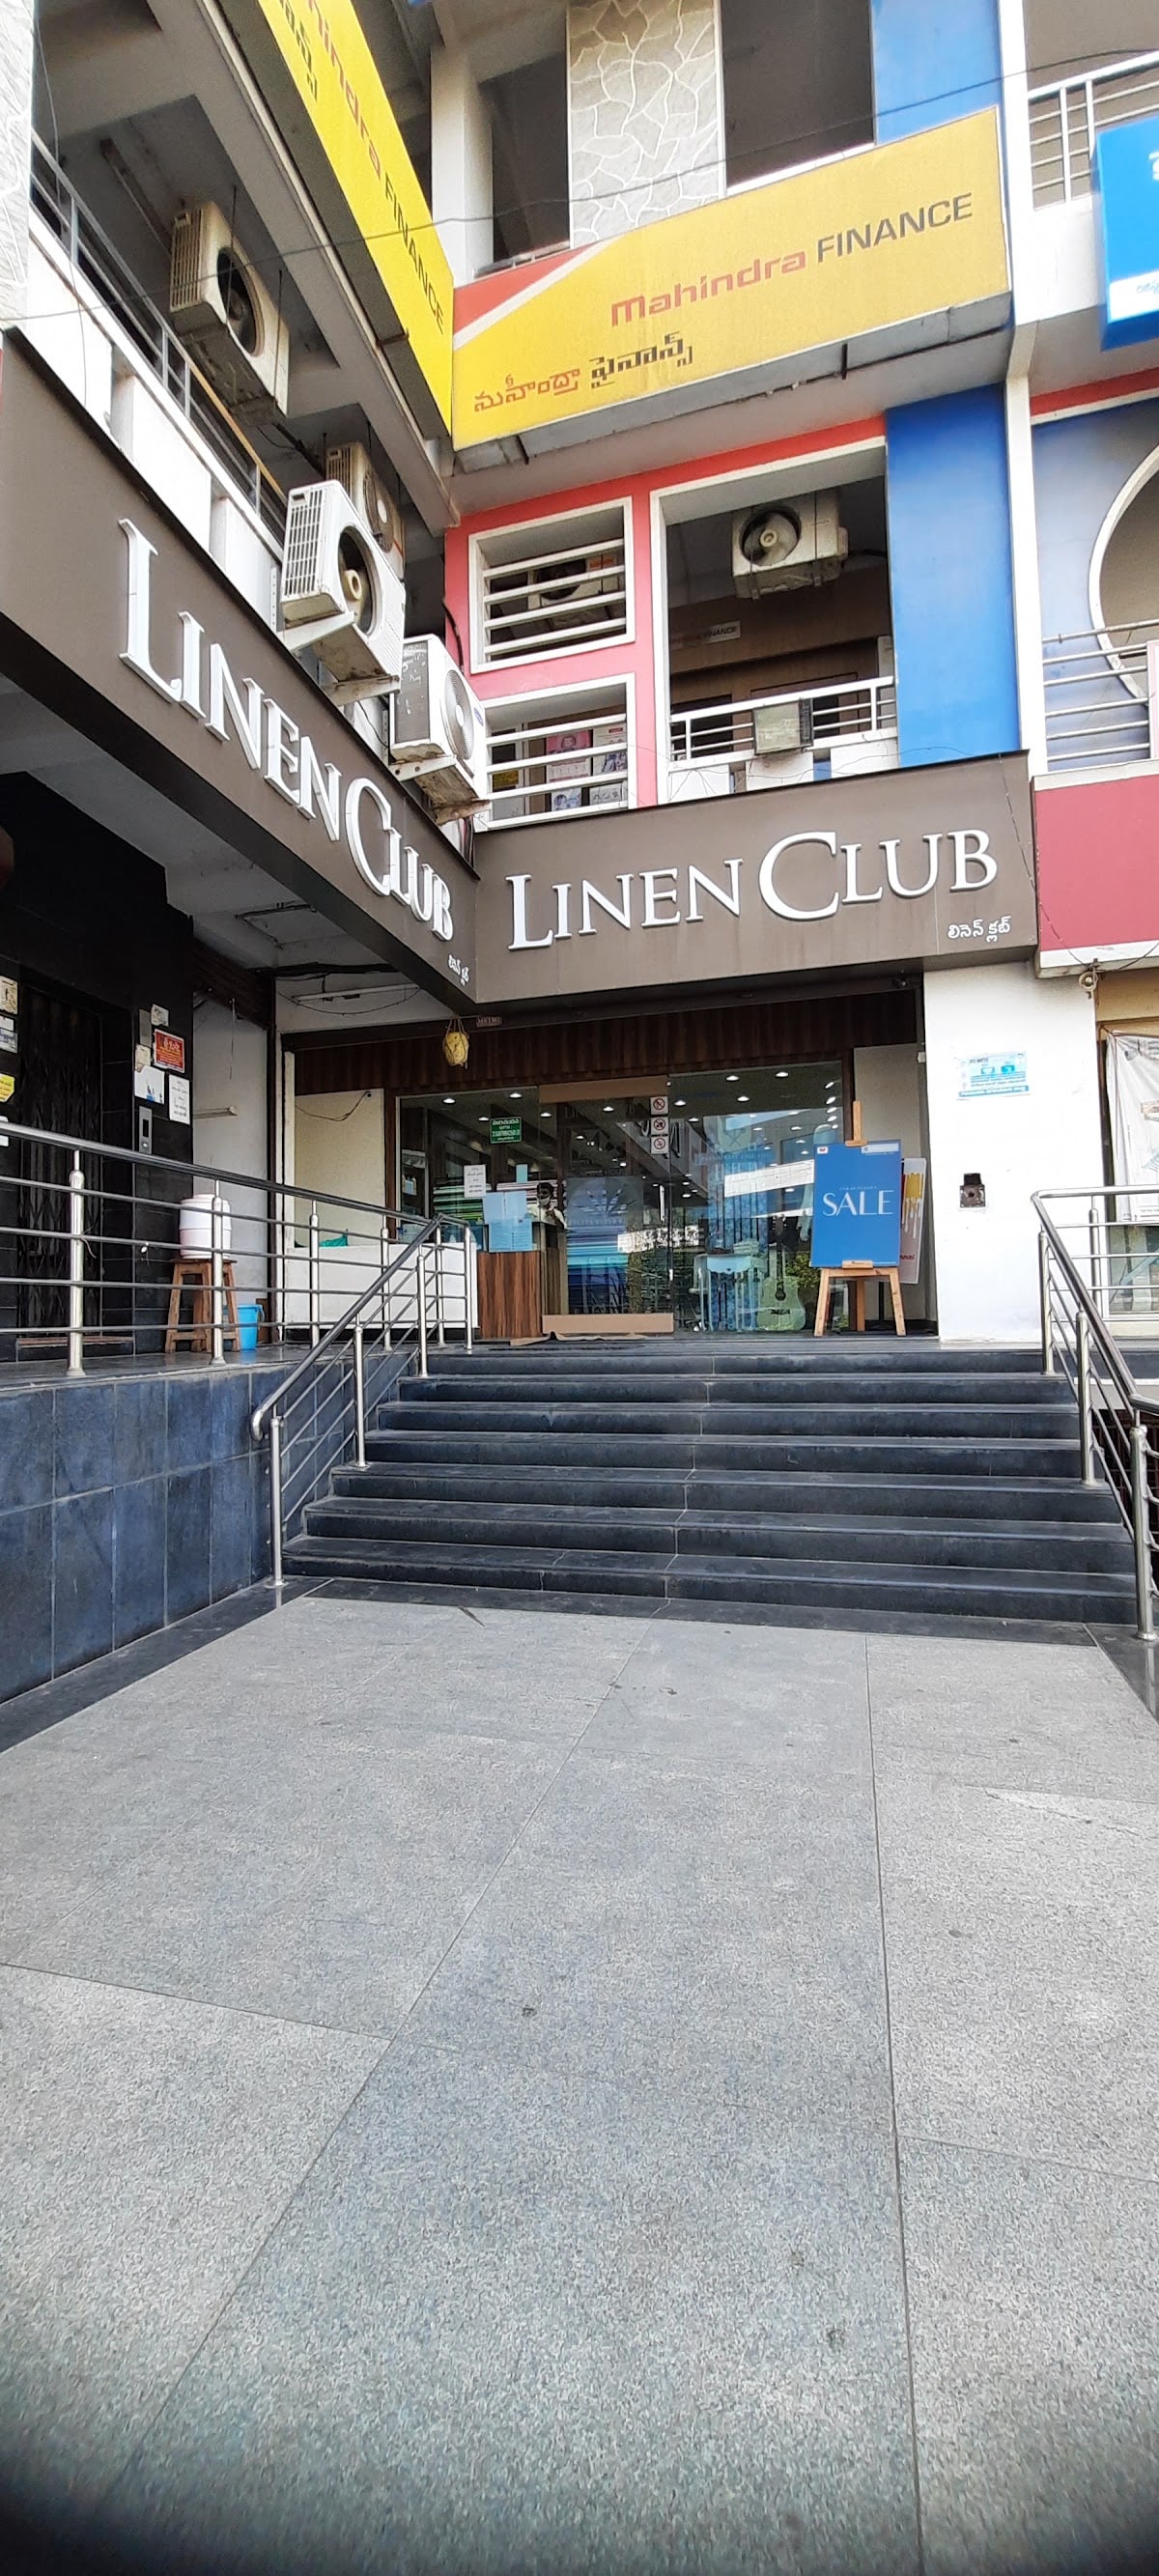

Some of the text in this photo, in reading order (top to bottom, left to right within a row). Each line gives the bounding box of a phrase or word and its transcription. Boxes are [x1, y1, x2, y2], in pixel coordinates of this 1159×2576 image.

[385, 171, 444, 335] FINANCE
[610, 192, 974, 327] Mahindra FINANCE
[117, 517, 454, 943] LINEN CLUB
[504, 828, 999, 951] LINEN CLUB
[947, 915, 1012, 943] లినెన్ క్లబ్
[822, 1189, 895, 1217] SALE
